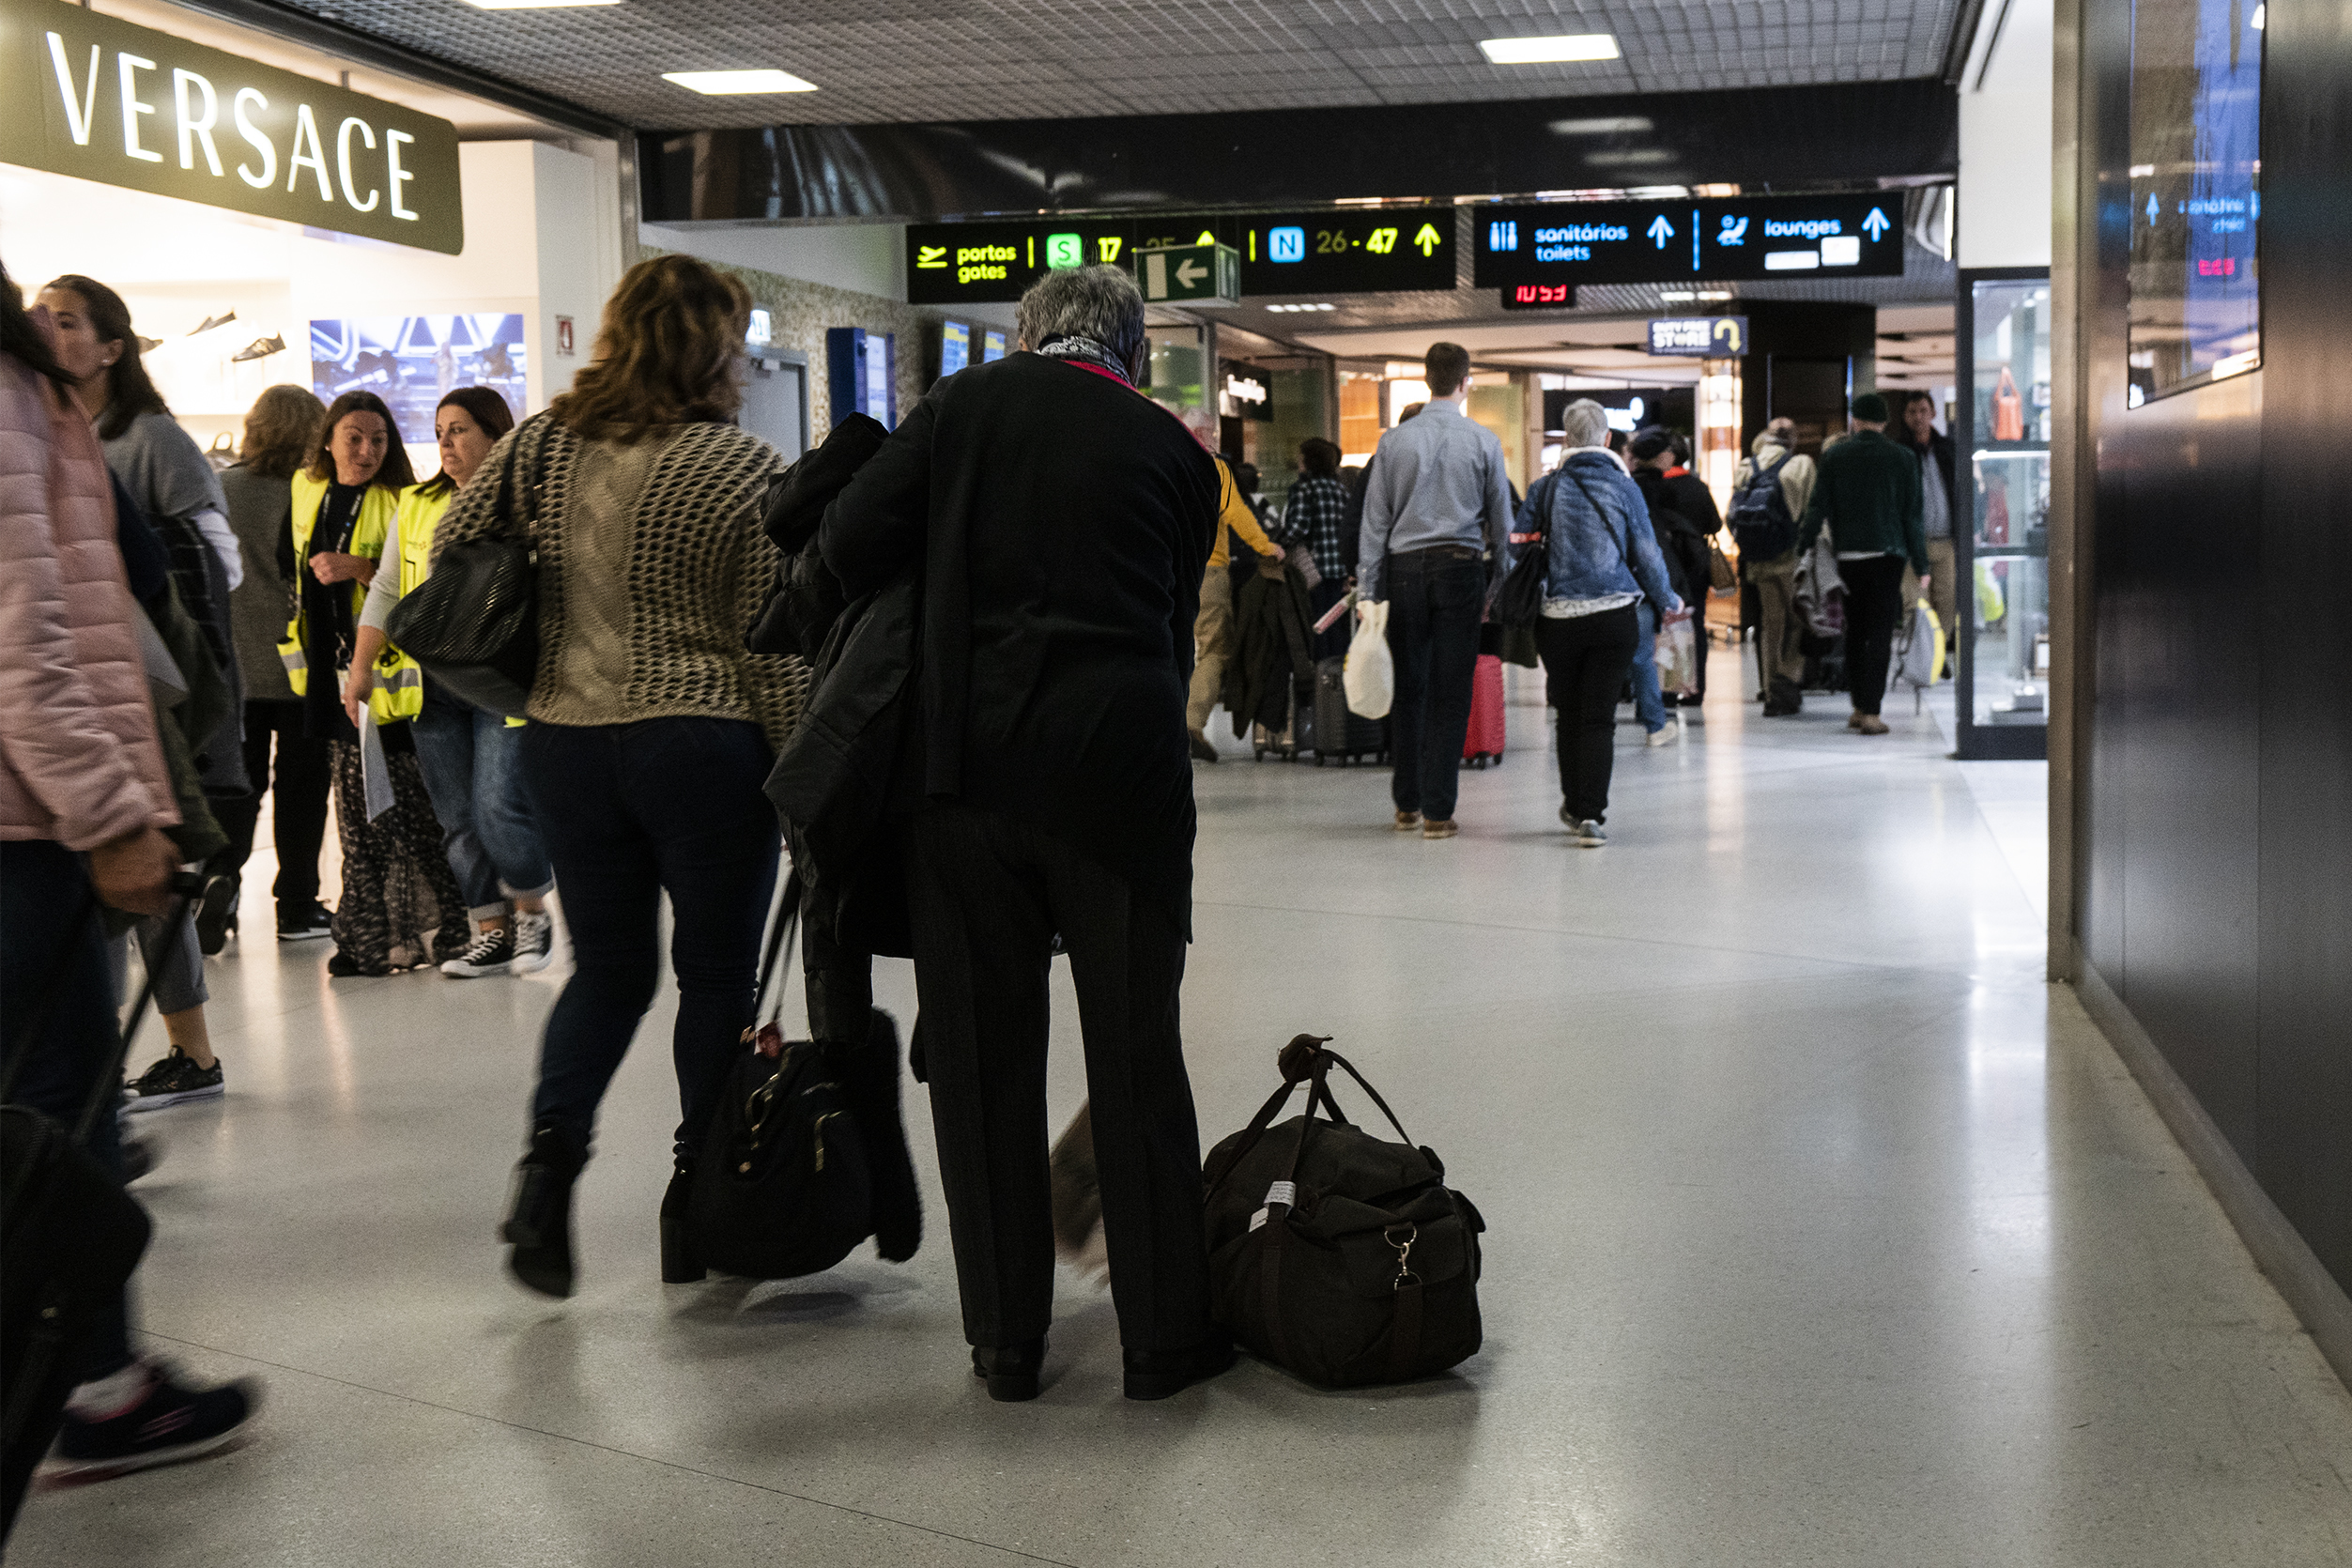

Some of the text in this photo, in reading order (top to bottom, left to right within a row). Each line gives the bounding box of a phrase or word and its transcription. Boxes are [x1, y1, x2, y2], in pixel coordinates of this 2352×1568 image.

[46, 32, 419, 222] VERSACE
[1534, 223, 1629, 243] sanitários
[1764, 218, 1841, 239] lounges
[1057, 240, 1071, 261] S
[1098, 237, 1122, 262] 17
[1279, 234, 1295, 255] N
[1316, 230, 1347, 254] 26
[1365, 227, 1398, 254] 47
[957, 244, 1017, 266] portas
[1535, 244, 1591, 262] toilets
[958, 263, 1007, 284] gates
[1653, 331, 1711, 348] STORE
